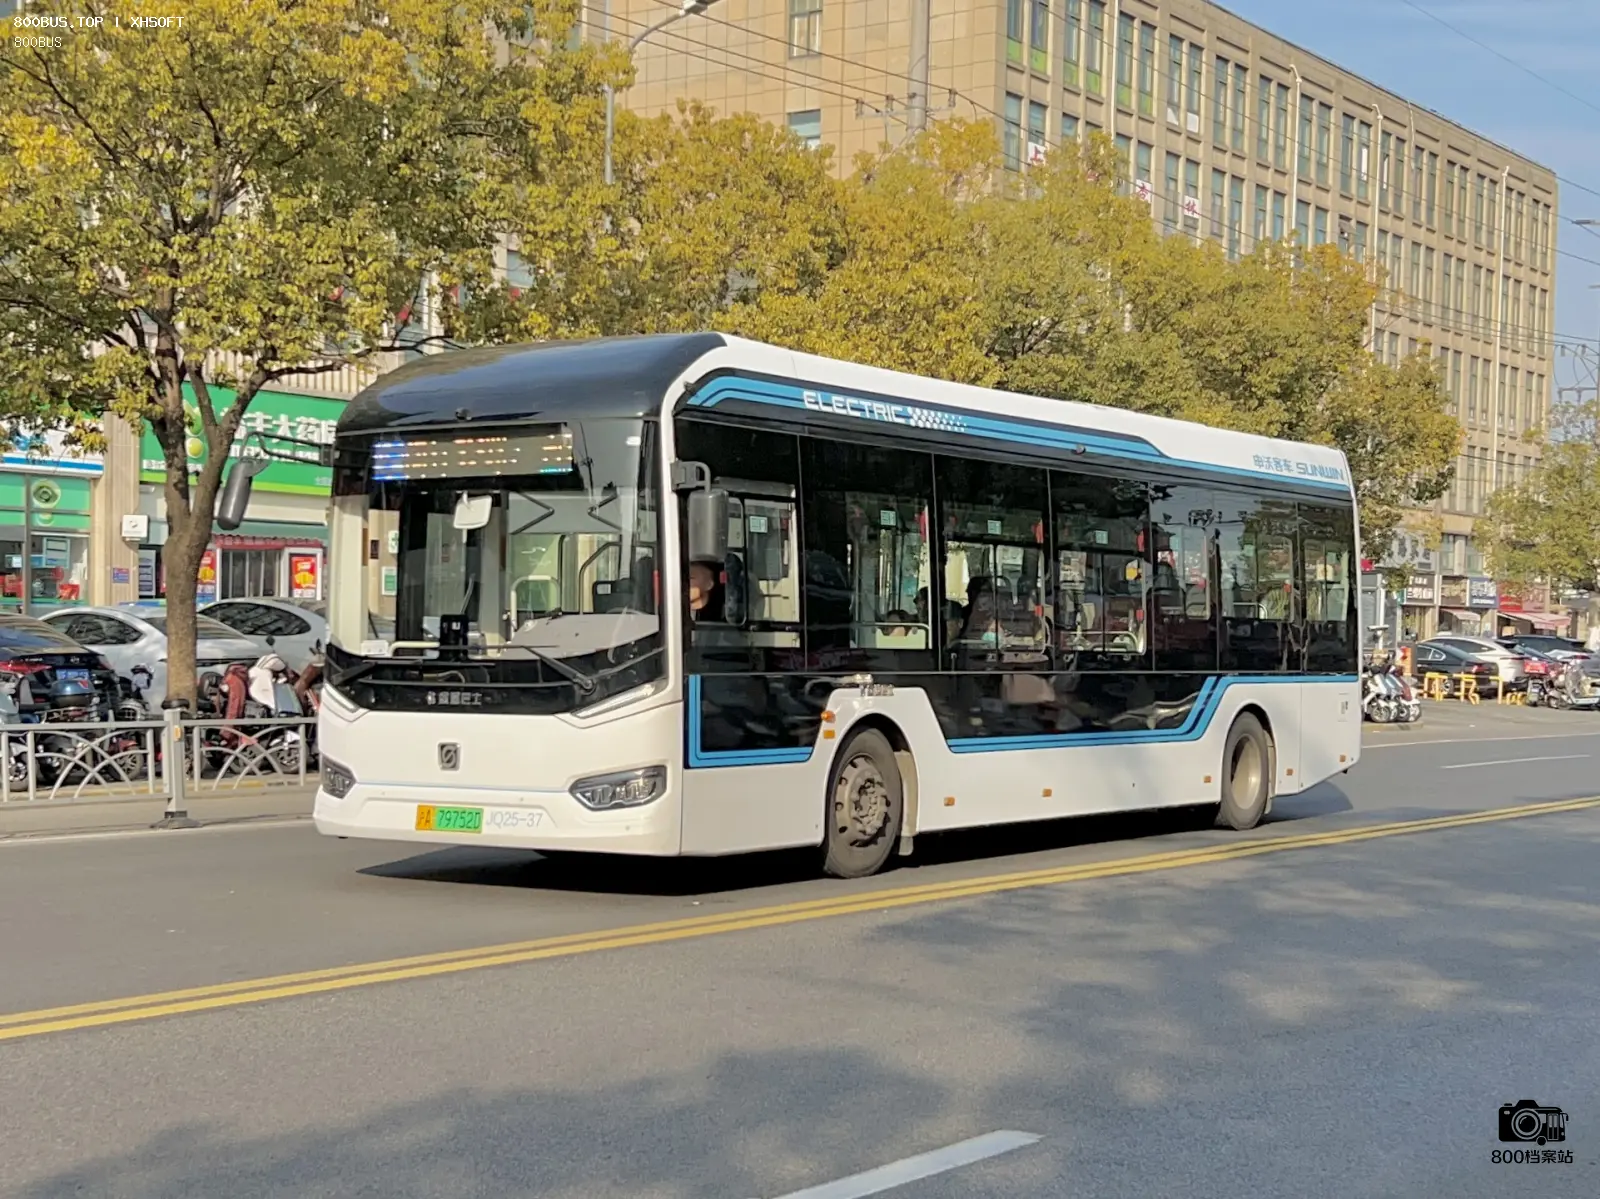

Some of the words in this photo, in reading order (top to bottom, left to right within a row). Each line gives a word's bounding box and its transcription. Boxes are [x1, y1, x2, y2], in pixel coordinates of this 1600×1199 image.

[803, 391, 906, 423] ELECTRIC
[1296, 461, 1345, 481] SUNWIN
[486, 810, 544, 828] JQ25-37
